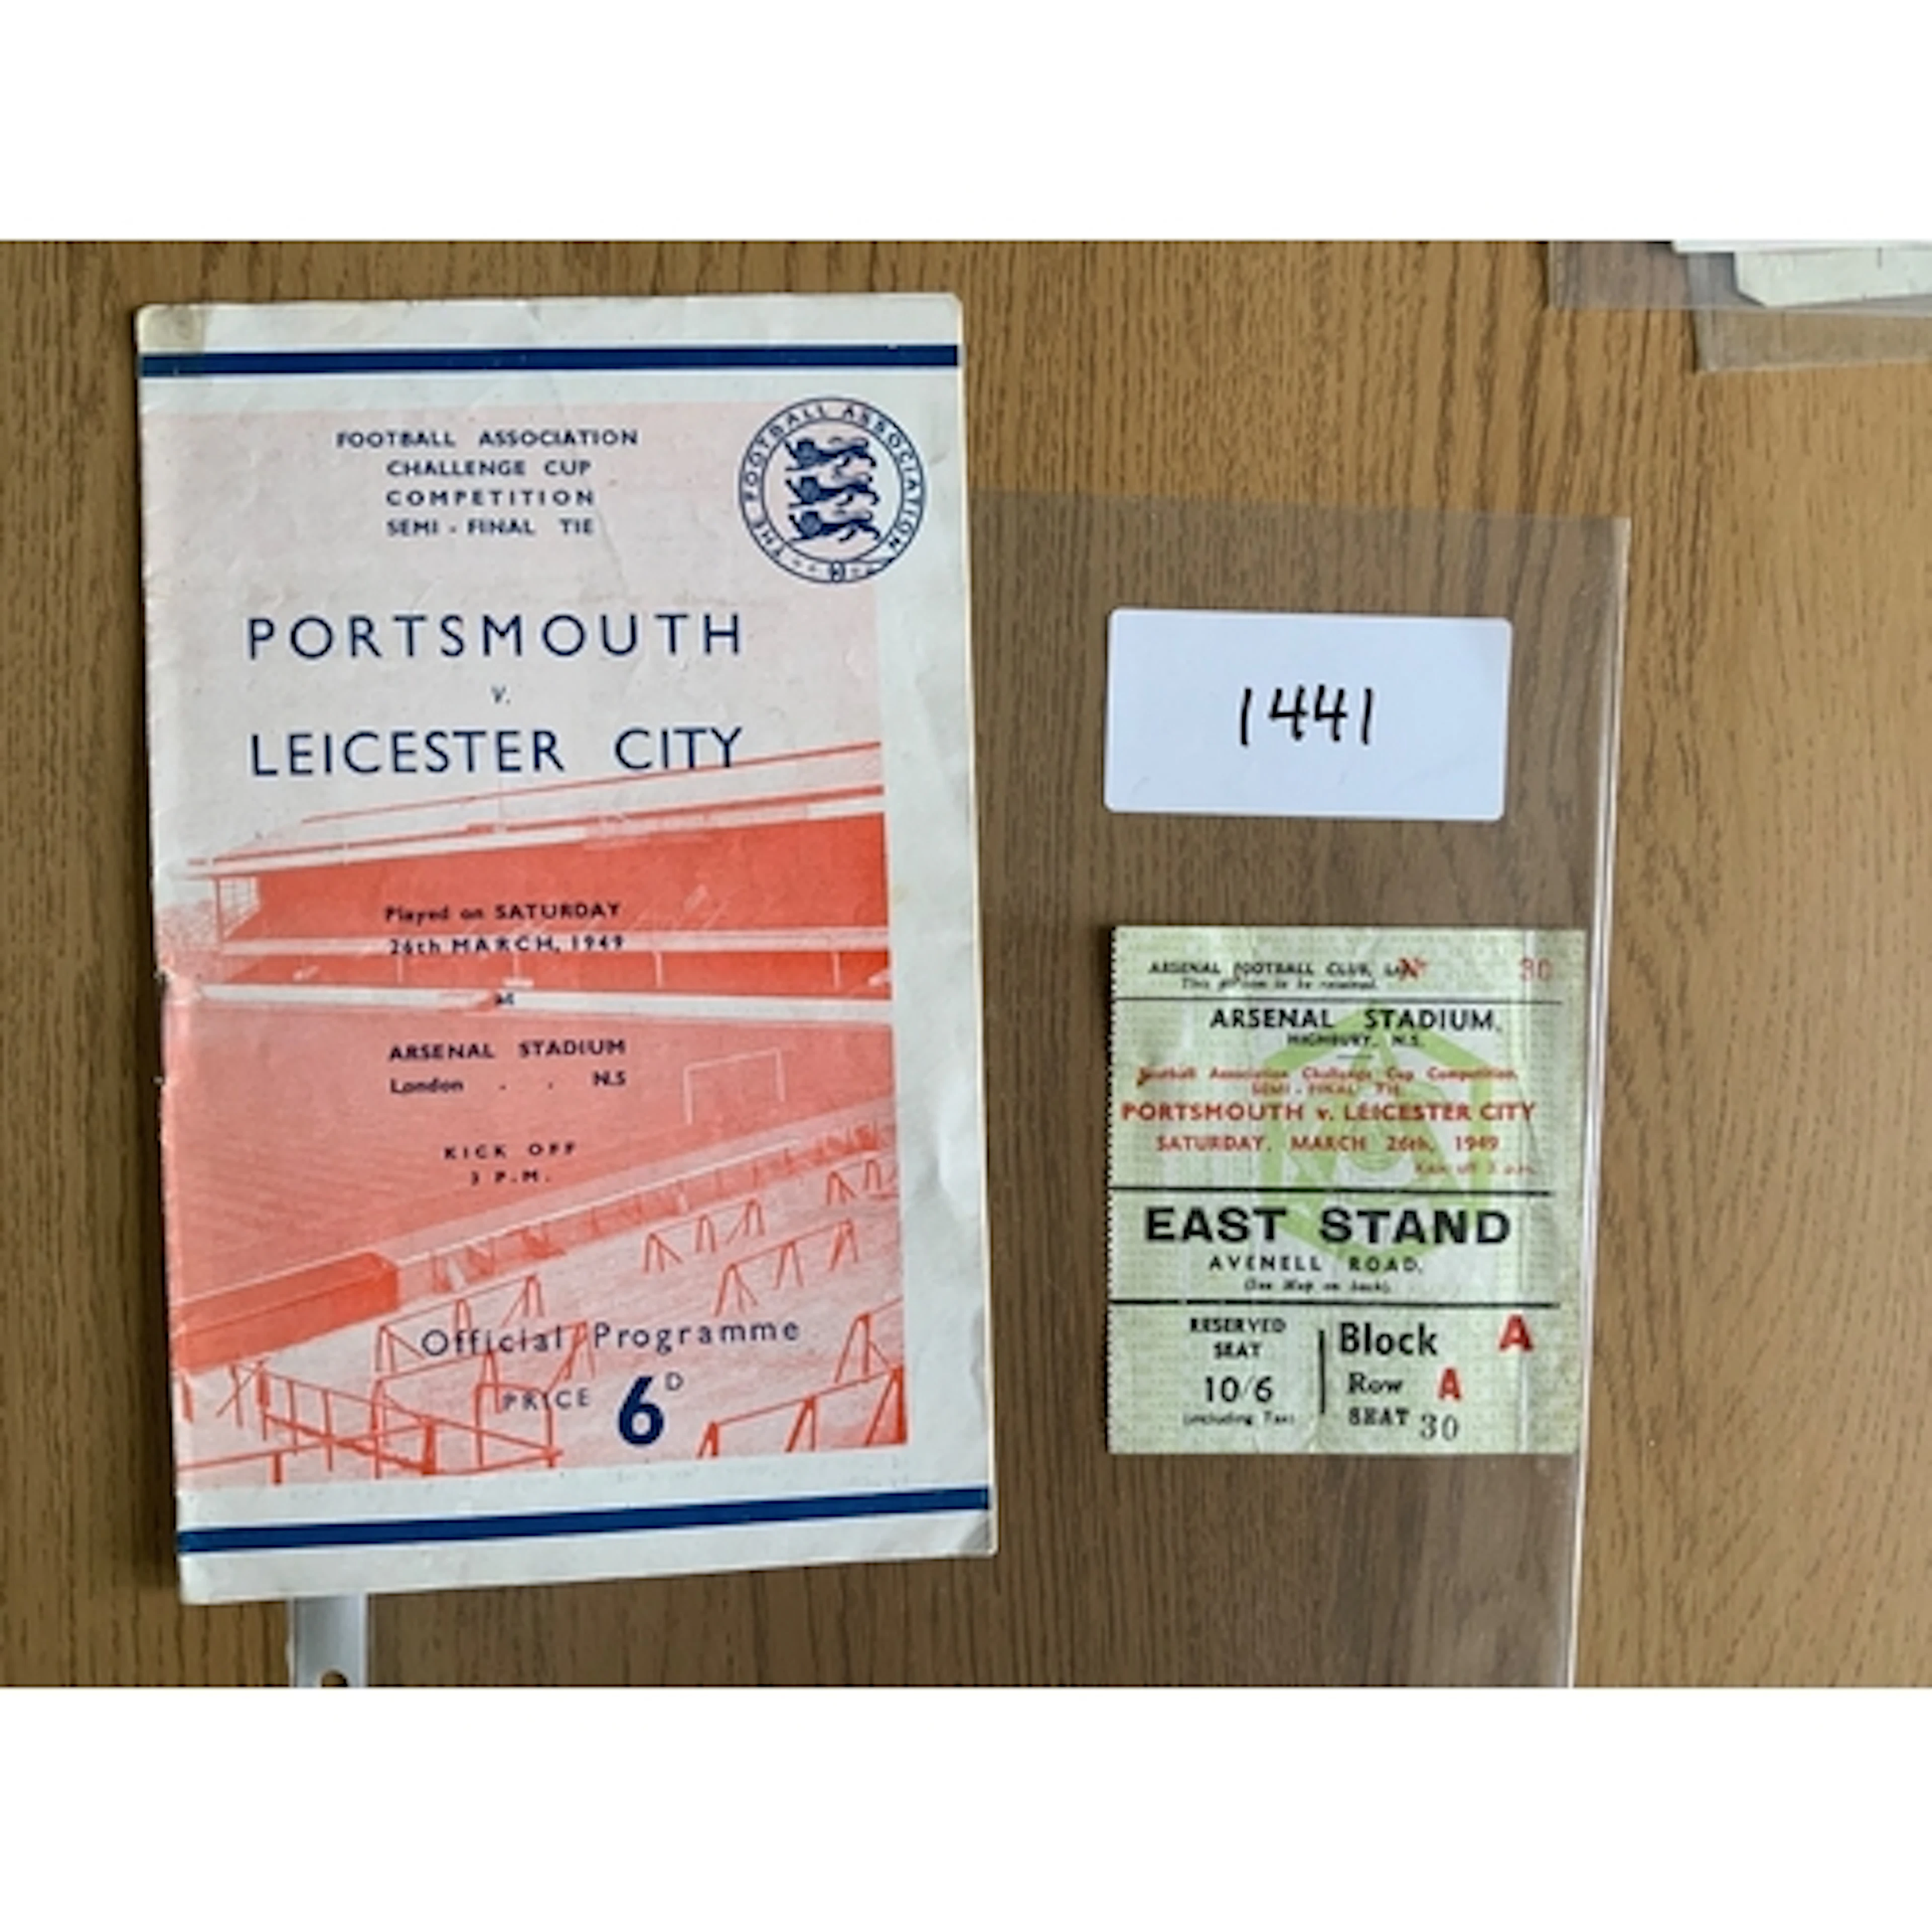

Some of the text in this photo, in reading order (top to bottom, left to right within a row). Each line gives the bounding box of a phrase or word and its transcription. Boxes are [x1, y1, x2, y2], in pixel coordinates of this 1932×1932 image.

[336, 429, 638, 448] FOOTBALL ASSOCIATION
[386, 459, 592, 476] CHALLENGE CUP
[385, 490, 594, 507] COMPETITION
[386, 519, 439, 536] SEMI
[467, 519, 535, 536] FINAL
[559, 518, 594, 534] TIE
[249, 613, 741, 659] PORTSMOUTH
[1240, 685, 1375, 747] 1441
[251, 727, 742, 776] LEICESTER CITY
[385, 902, 621, 925] Played on SATURDAY
[389, 936, 624, 954] 26th MARCH, 1949
[1148, 961, 1221, 974] ARSENAL
[1234, 961, 1314, 976] FOOTBALL
[1210, 1008, 1335, 1028] ARSENAL
[388, 1039, 626, 1061] ARSENAL STADIUM
[1386, 1067, 1414, 1081] Cup
[390, 1079, 464, 1094] London
[1252, 1082, 1290, 1095] SEMI
[1120, 1103, 1304, 1121] PORTSMOUTH
[1345, 1104, 1471, 1121] LEICESTER
[1480, 1103, 1535, 1121] CITY
[444, 1143, 576, 1160] KICK OFF
[1291, 1136, 1366, 1152] MARCH
[1456, 1136, 1499, 1152] 1949
[1145, 1207, 1511, 1245] EAST STAND
[1209, 1256, 1322, 1272] AVENELL
[1189, 1317, 1286, 1333] RESERVED
[422, 1319, 800, 1356] Official Programme
[1339, 1314, 1535, 1356] Block A
[1214, 1341, 1263, 1359] SEAT
[1347, 1367, 1462, 1401] Row A
[504, 1387, 591, 1412] PRICE
[1348, 1407, 1459, 1441] SEAT 30
